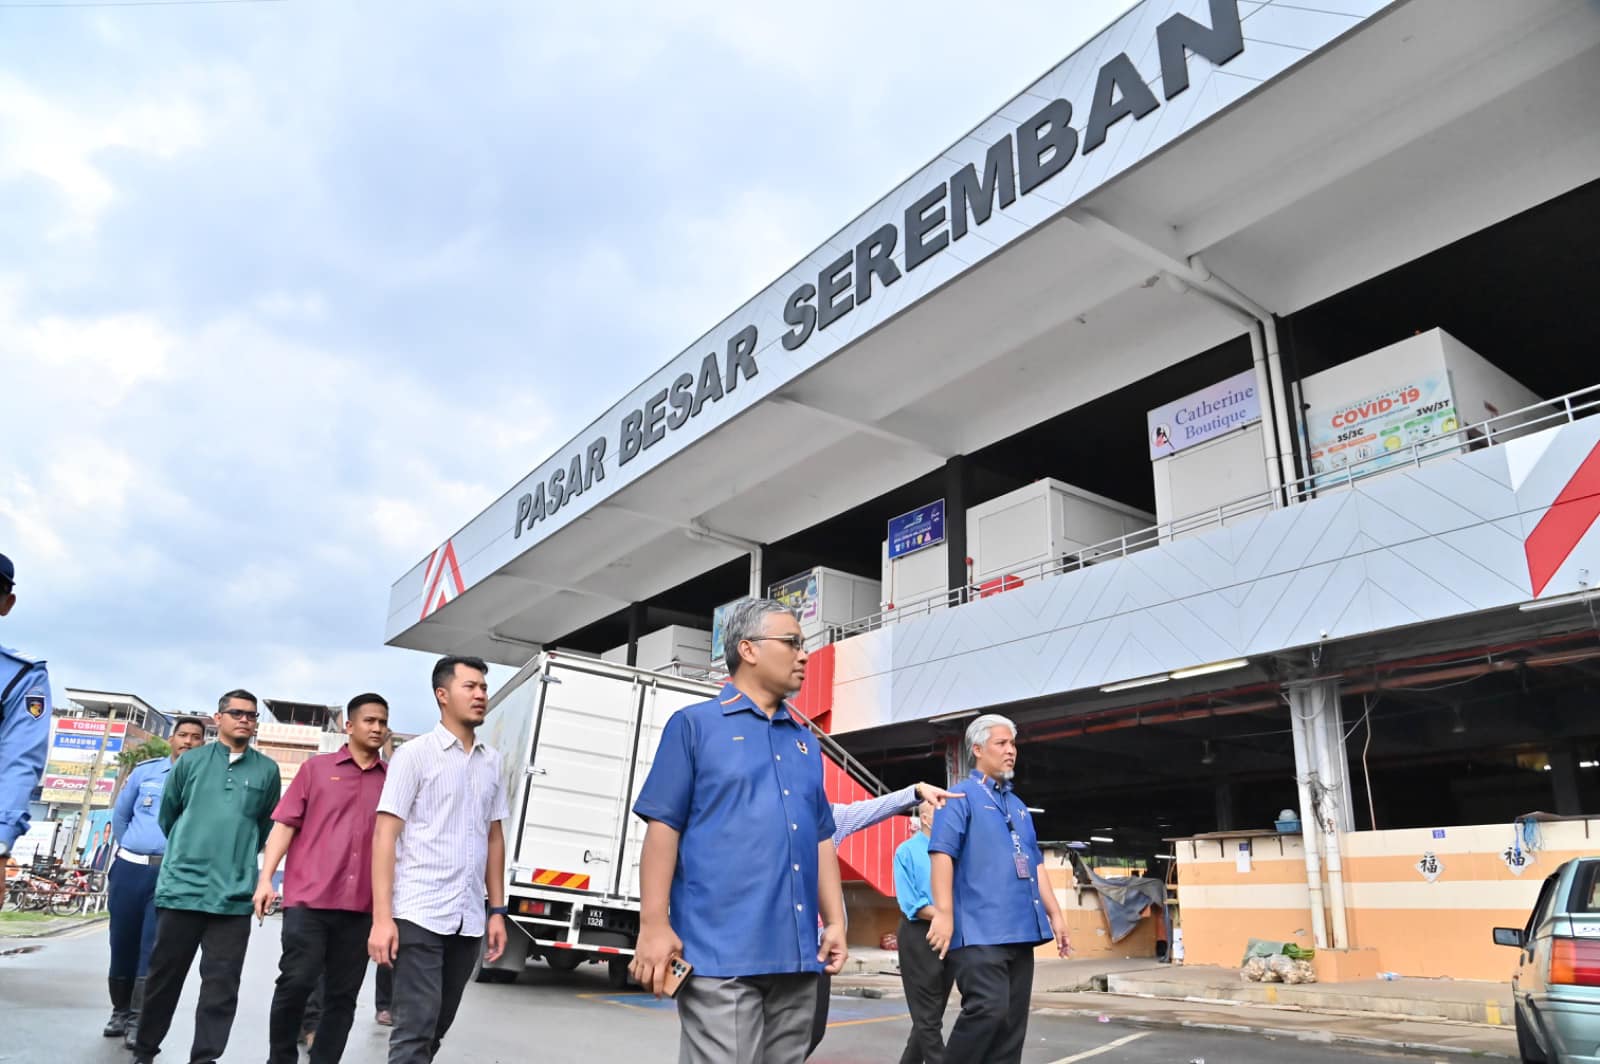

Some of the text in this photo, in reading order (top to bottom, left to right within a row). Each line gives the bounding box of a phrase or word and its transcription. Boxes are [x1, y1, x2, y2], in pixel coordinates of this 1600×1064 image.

[514, 0, 1245, 539] PASAR BESAR SEREMBAN
[1175, 387, 1254, 425] Catherine
[1331, 388, 1420, 429] COVID-19
[1185, 409, 1247, 440] Boutique
[72, 721, 106, 730] TOSHIB
[60, 737, 97, 745] SAMSUNG
[1420, 855, 1438, 873] 福
[1504, 847, 1525, 866] 福
